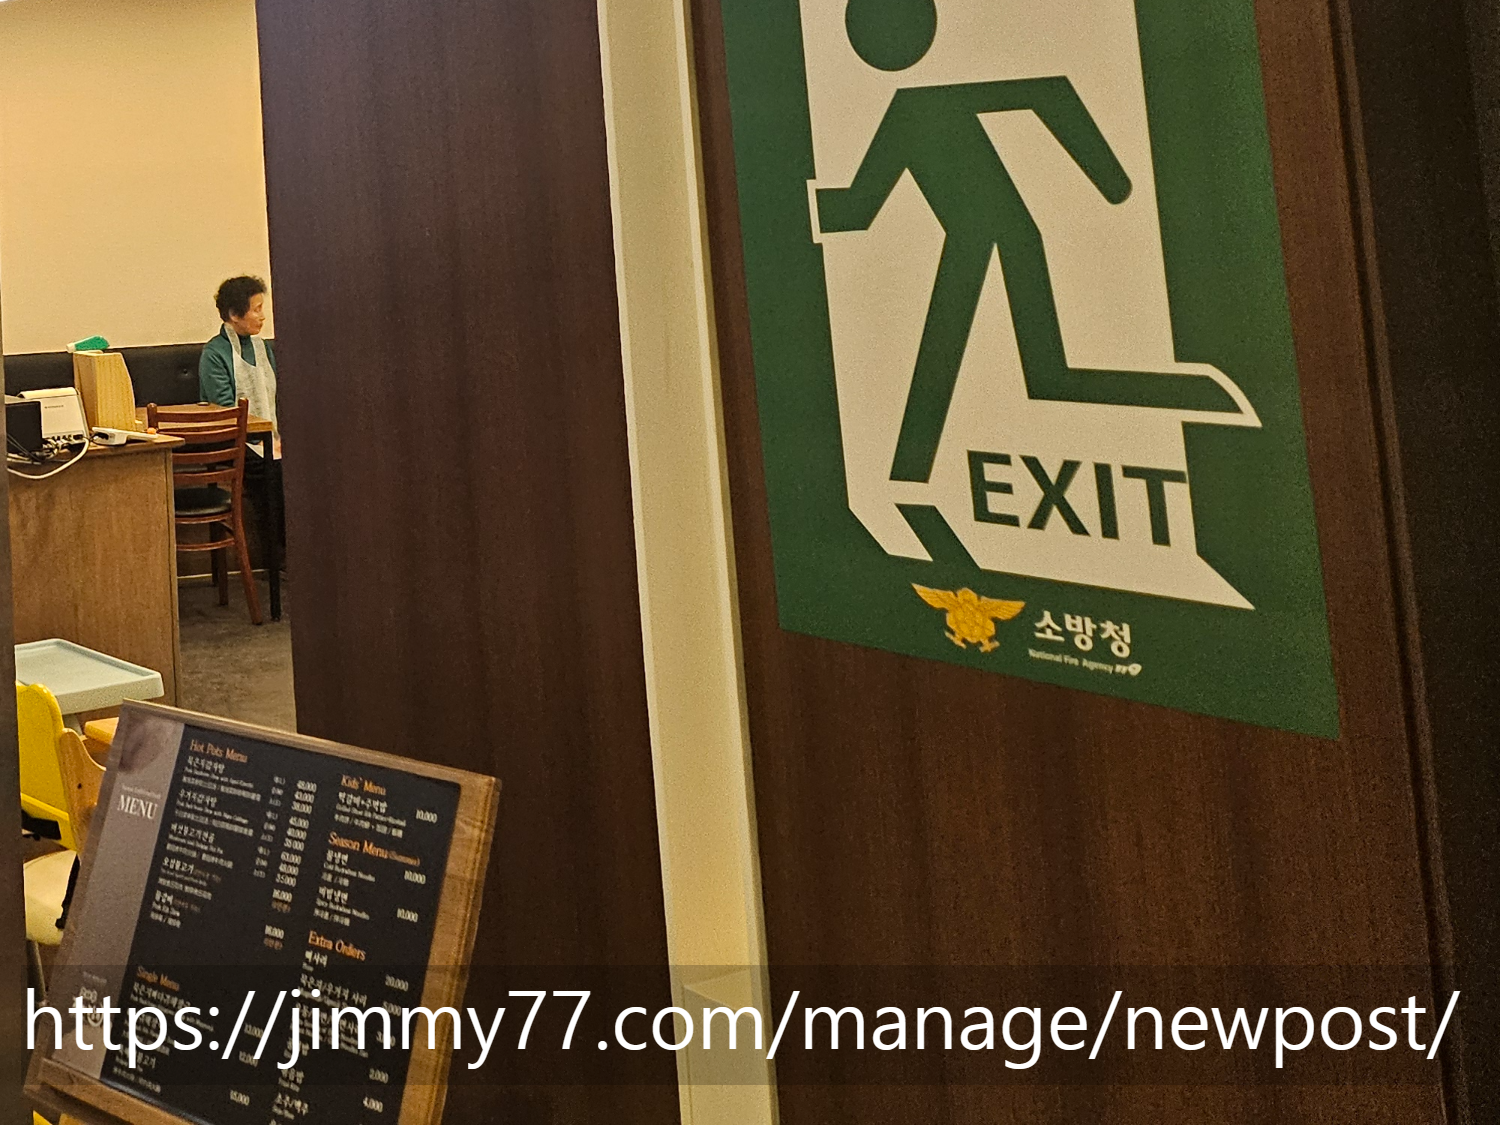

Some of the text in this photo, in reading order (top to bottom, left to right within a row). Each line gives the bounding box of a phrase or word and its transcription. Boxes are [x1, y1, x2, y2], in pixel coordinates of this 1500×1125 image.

[967, 449, 1188, 548] EXIT
[1034, 610, 1131, 659] 소방청
[117, 794, 158, 819] MENU
[328, 830, 360, 851] Season
[309, 930, 334, 951] Extra
[335, 939, 367, 962] Orders
